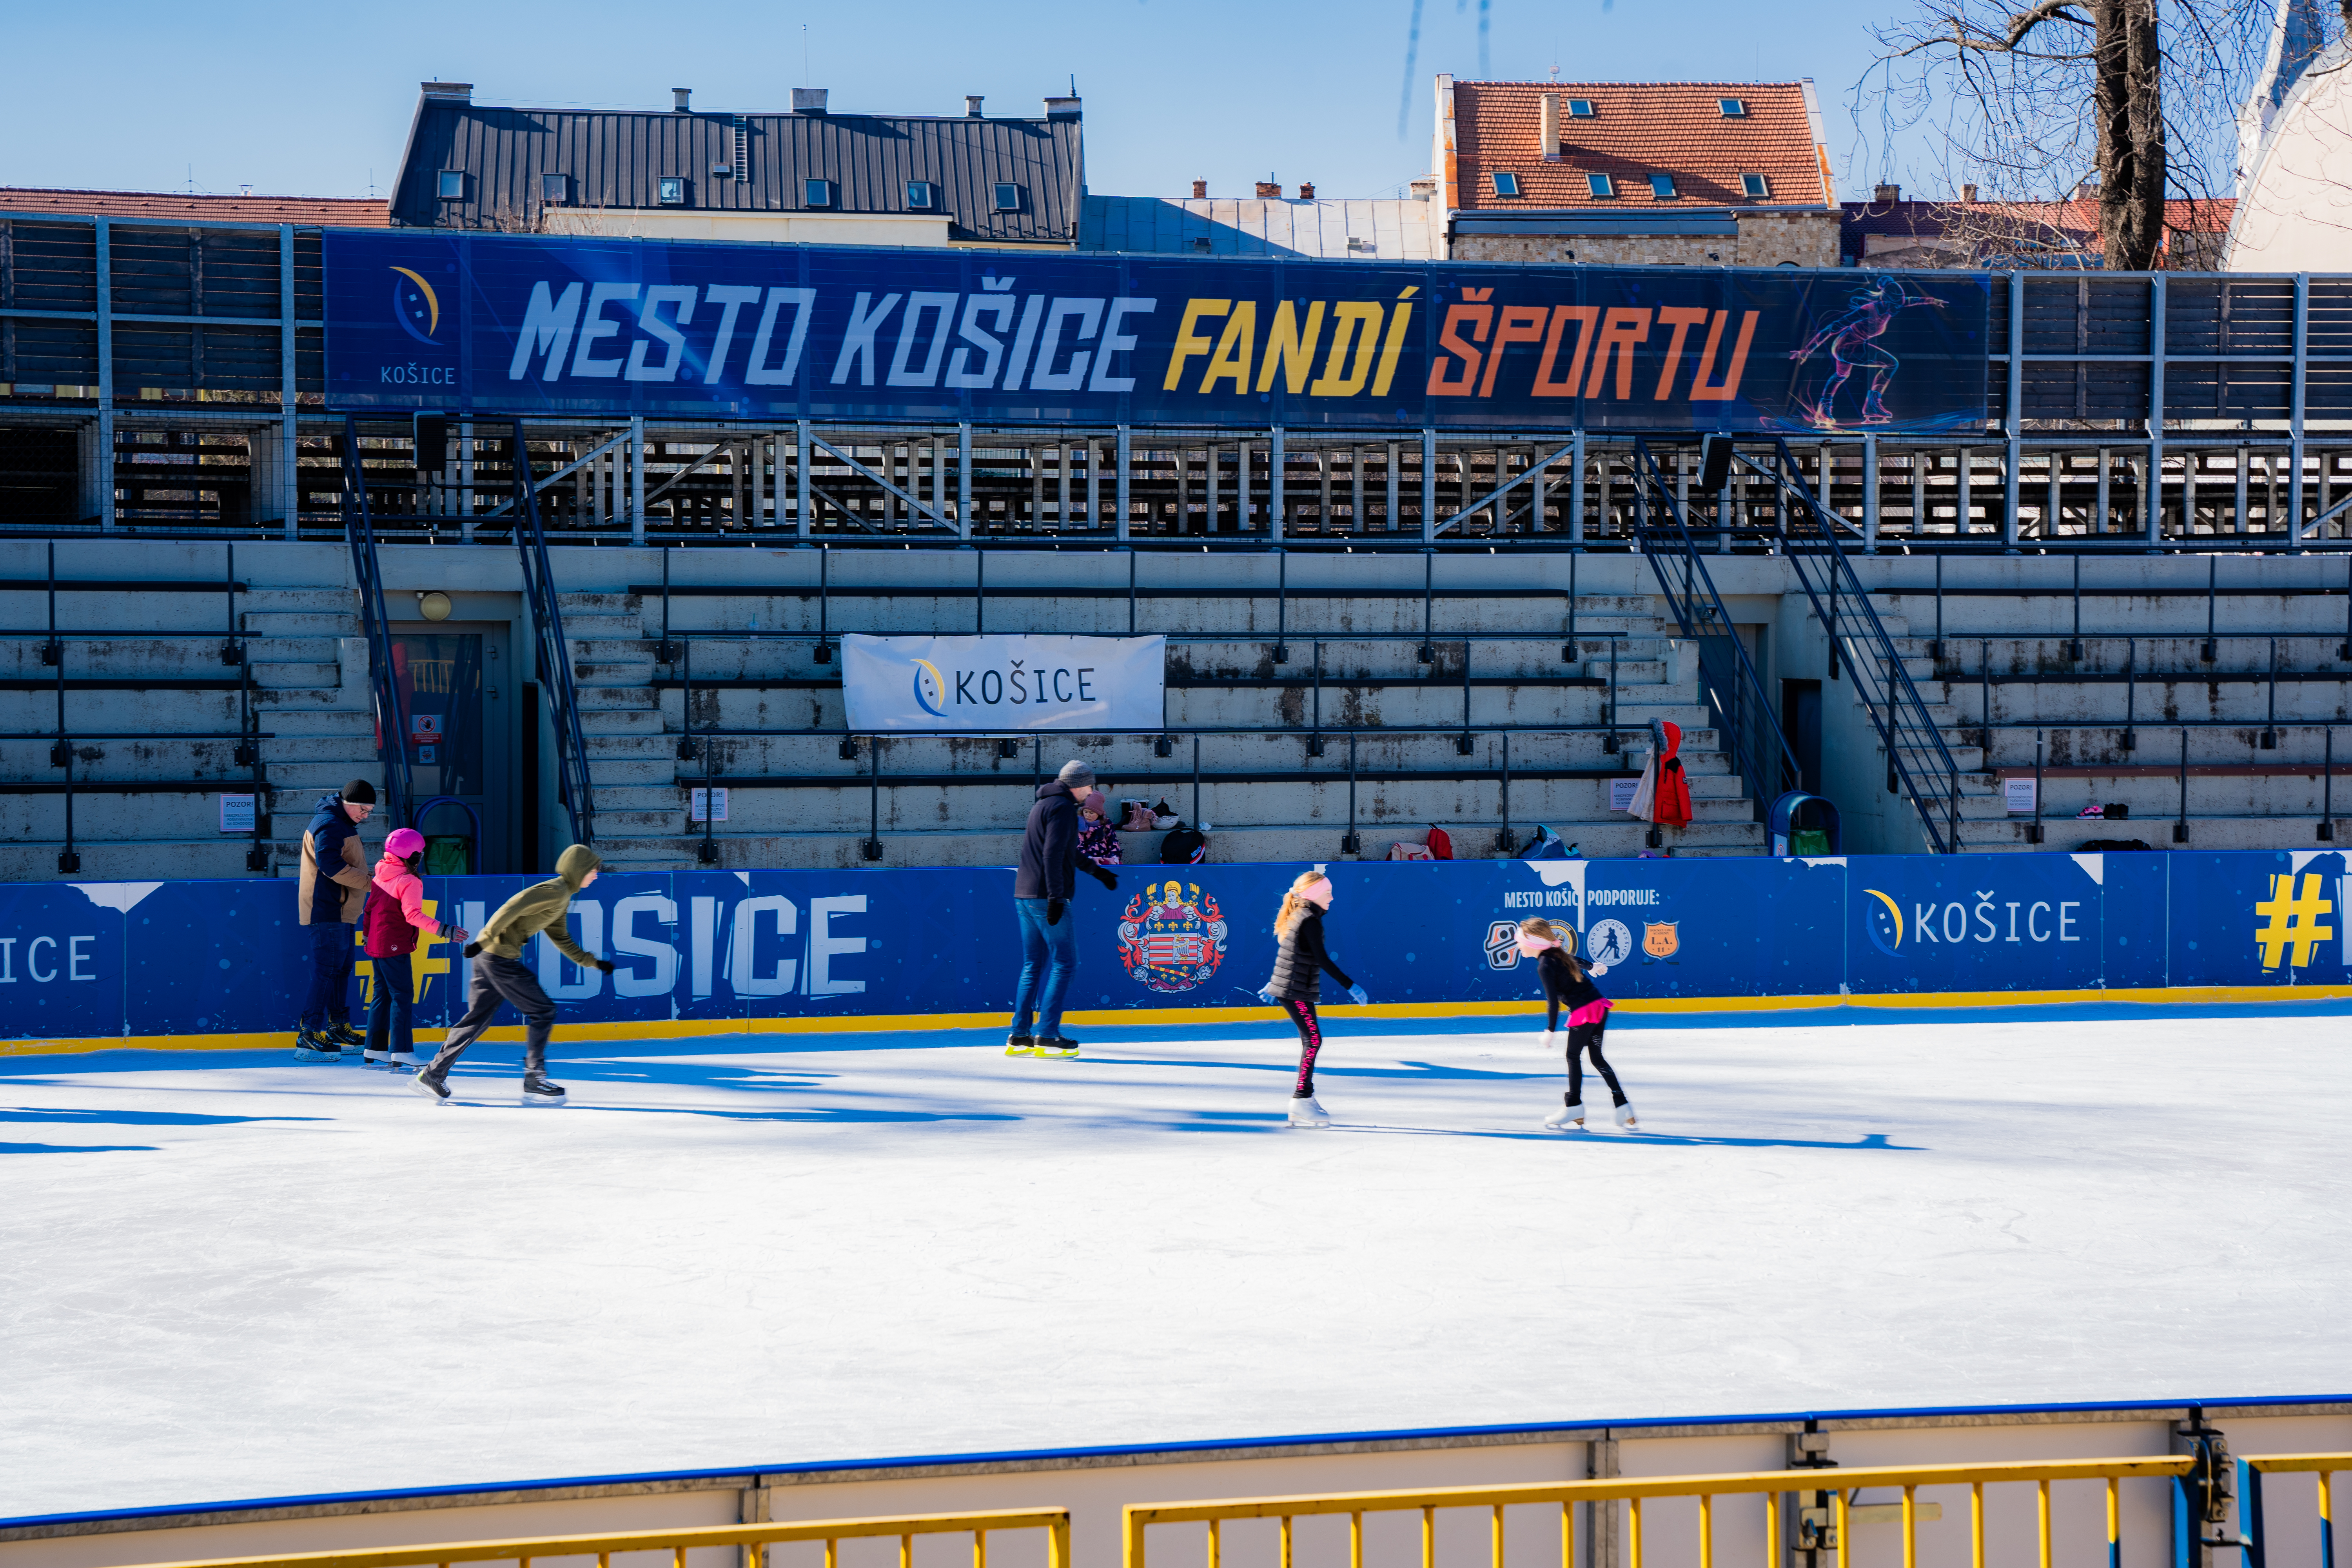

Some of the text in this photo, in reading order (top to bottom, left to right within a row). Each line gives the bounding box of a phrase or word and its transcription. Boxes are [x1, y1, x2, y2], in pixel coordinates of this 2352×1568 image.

[509, 276, 1760, 401] MESTO KOŠICE FANDÍ ŠPORTU
[381, 363, 456, 385] KOŠICE
[956, 659, 1096, 705] KOŠICE
[1504, 888, 1660, 908] MESTO KOŠIC PODPORUJE:
[1596, 922, 1623, 932] CENTRUM
[1915, 890, 2080, 943] KOŠICE
[1651, 936, 1673, 945] L.A.
[0, 935, 96, 982] ICE
